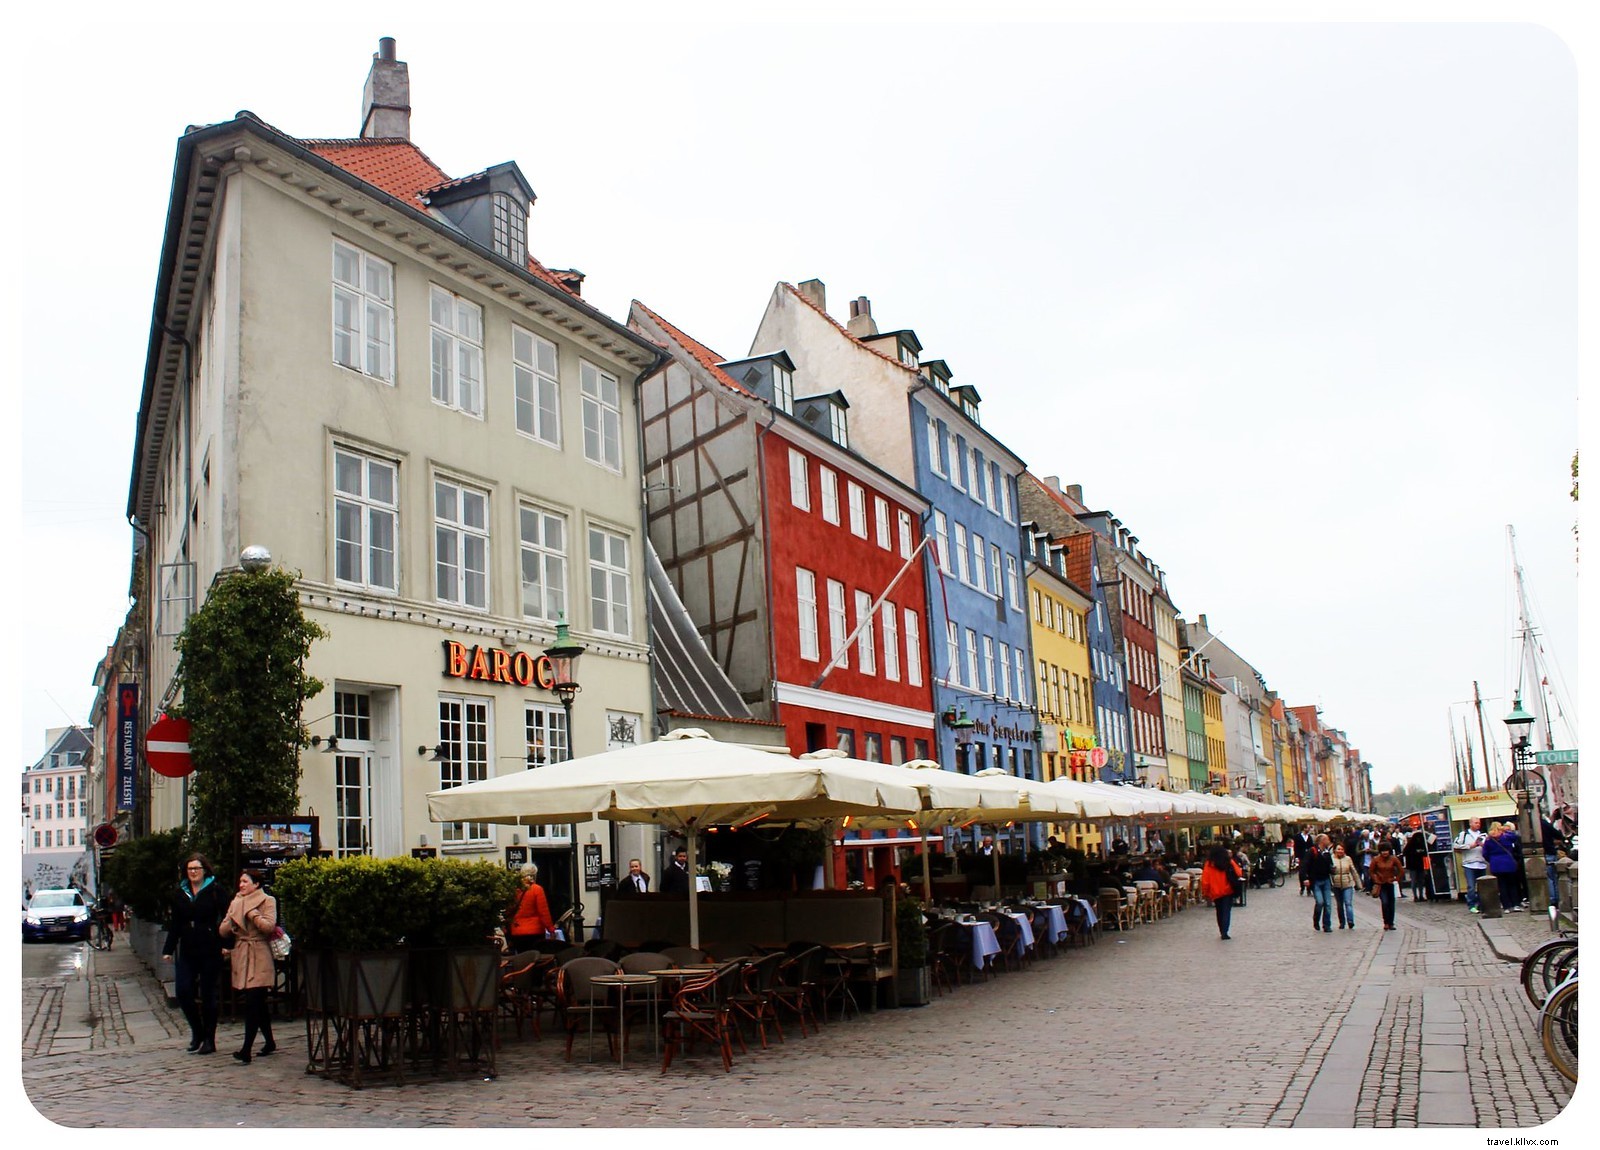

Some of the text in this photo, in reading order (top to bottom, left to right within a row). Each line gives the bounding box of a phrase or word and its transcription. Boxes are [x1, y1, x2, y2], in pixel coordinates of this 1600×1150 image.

[124, 721, 133, 770] RESTAURANT
[1472, 794, 1499, 802] Michael
[586, 855, 600, 867] LIVE
